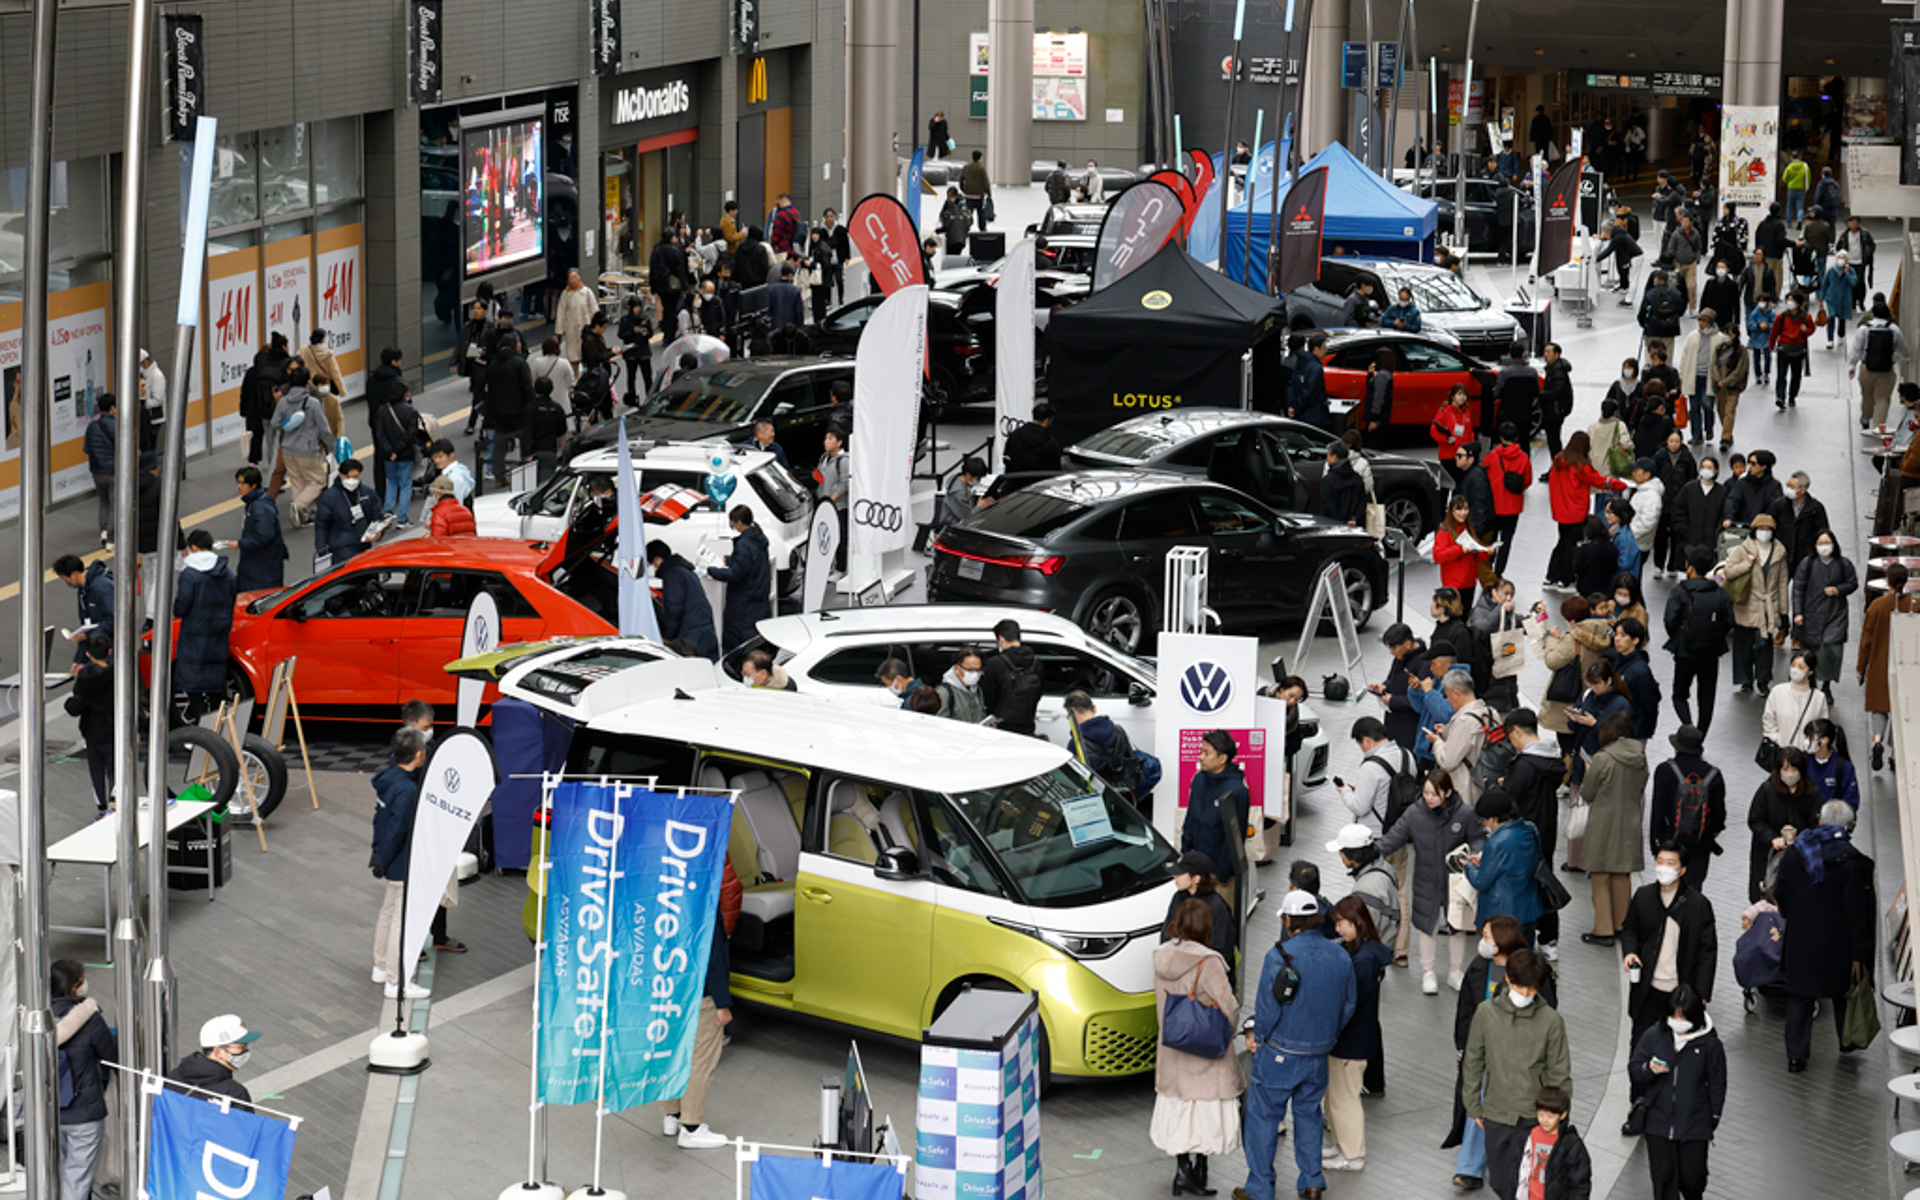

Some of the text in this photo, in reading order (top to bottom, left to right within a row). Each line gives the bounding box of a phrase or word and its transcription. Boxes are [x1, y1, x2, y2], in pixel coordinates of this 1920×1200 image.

[615, 79, 689, 125] McDonald's
[323, 258, 354, 321] H&M
[215, 284, 251, 352] H&M
[1113, 392, 1173, 409] LOTUS
[425, 792, 472, 822] ID.BUZZ
[629, 901, 647, 987] ASV/ADAS
